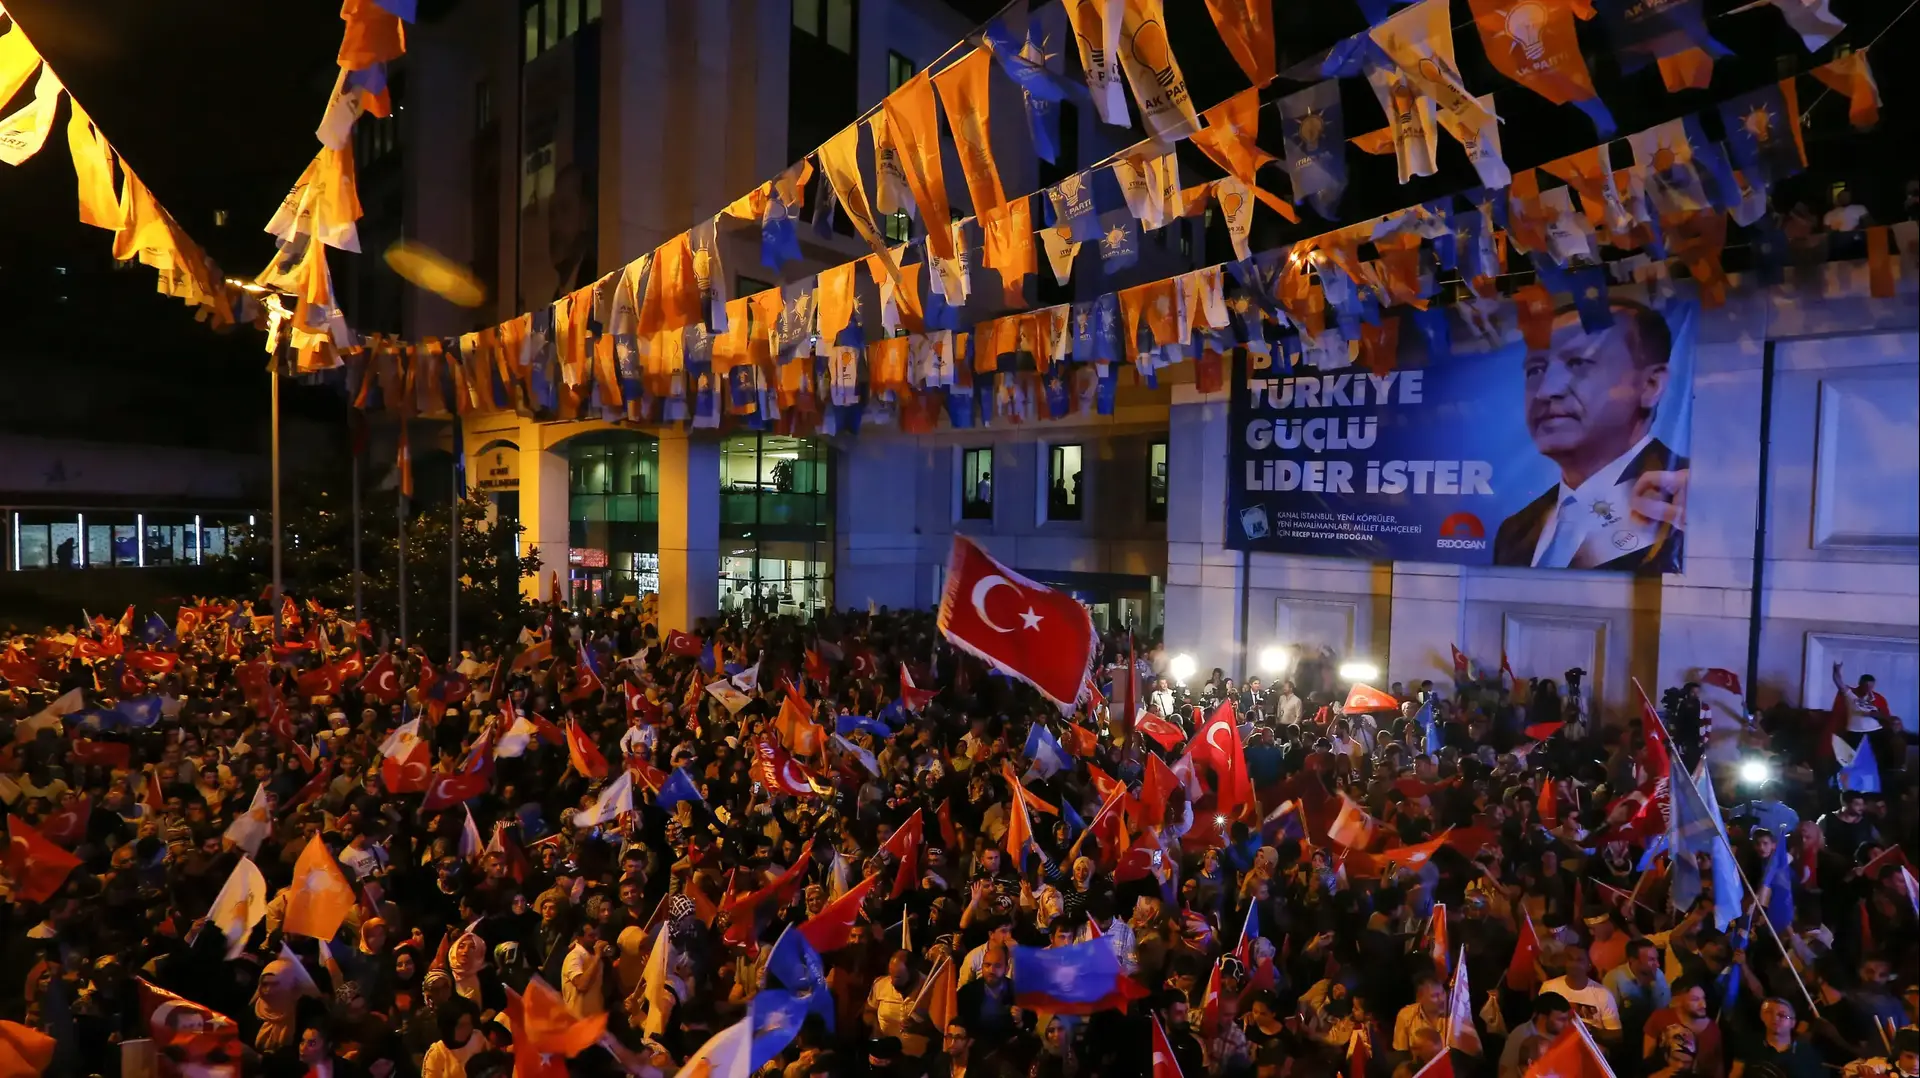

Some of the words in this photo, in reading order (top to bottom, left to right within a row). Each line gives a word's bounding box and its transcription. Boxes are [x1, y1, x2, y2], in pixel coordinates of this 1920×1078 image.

[1145, 95, 1164, 110] AK
[1247, 370, 1424, 409] TÜRKİYE
[1245, 416, 1378, 453] GÜÇLÜ
[1246, 459, 1355, 494] LİDER
[1366, 460, 1494, 495] İSTER
[1277, 511, 1299, 520] KANAL
[1337, 512, 1355, 521] YENİ
[1356, 512, 1397, 524] KÖPRÜLER,
[1277, 519, 1292, 529] YENİ
[1353, 522, 1379, 532] MİLLET
[1380, 524, 1422, 535] BAHÇELERİ
[1311, 531, 1335, 540] TAYYİP
[1335, 532, 1373, 541] ERDOĞAN
